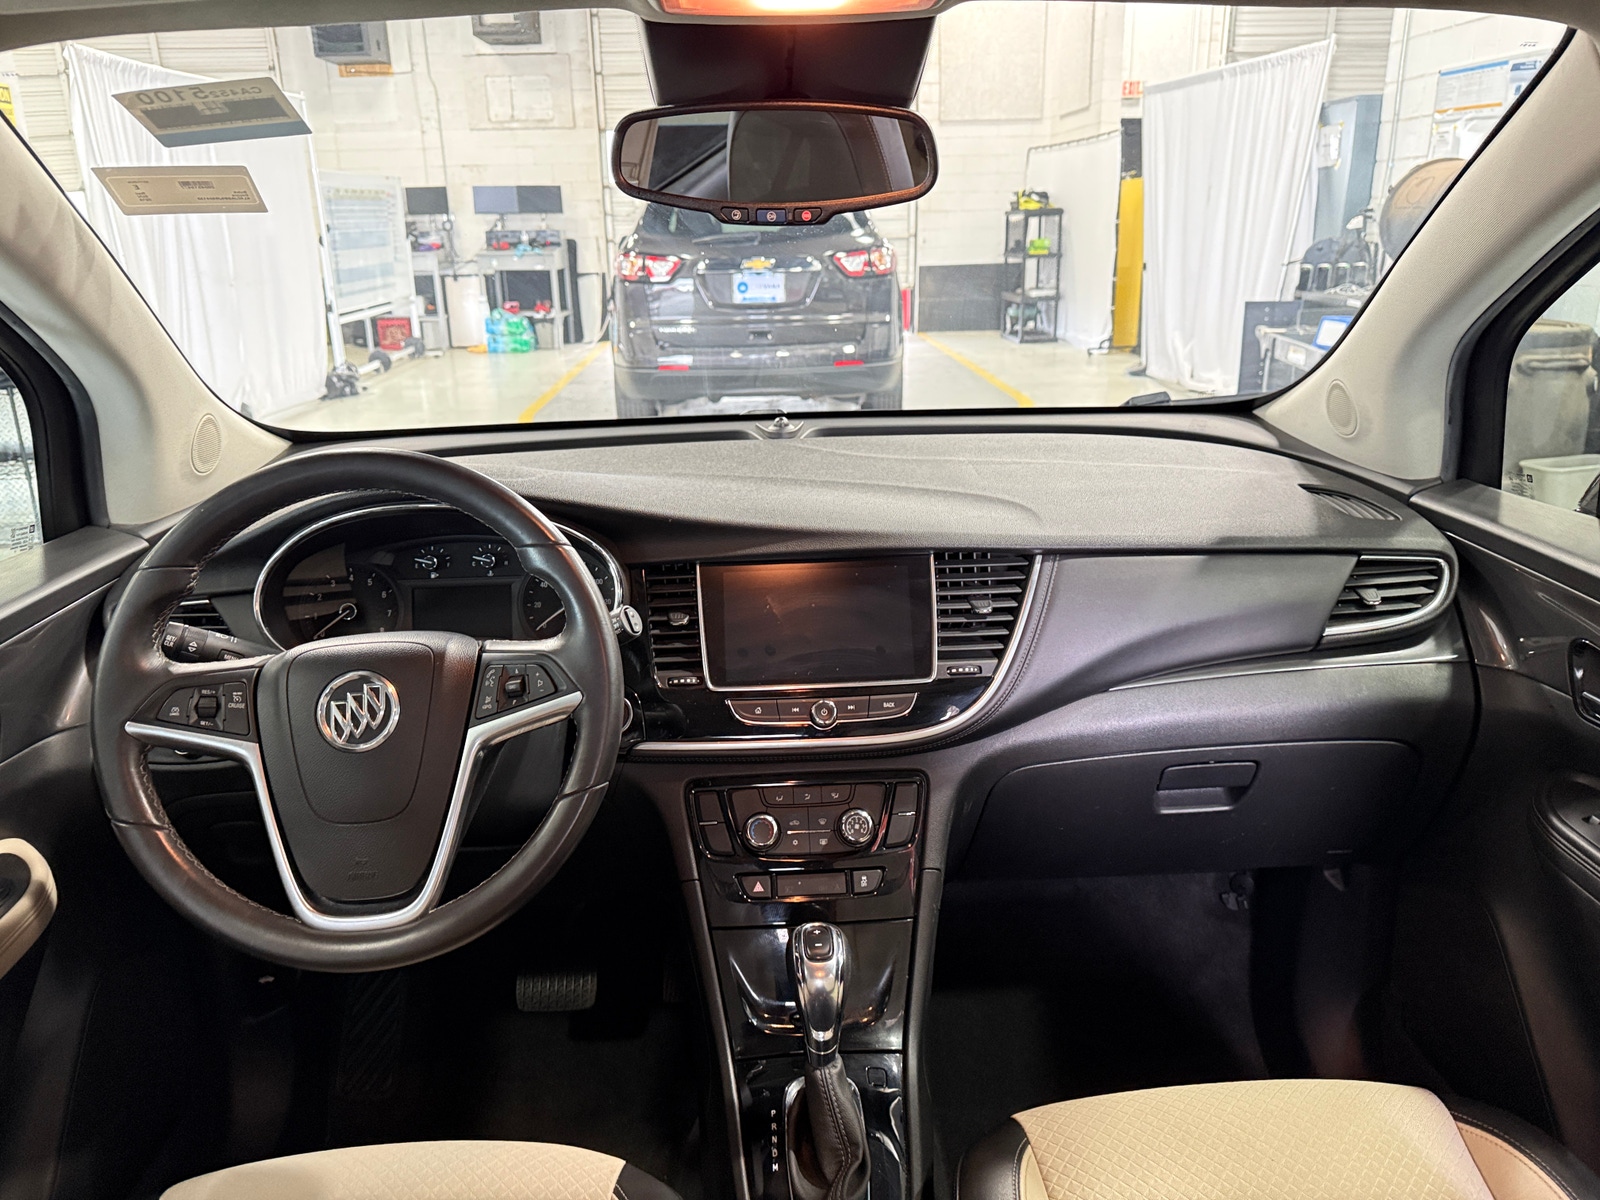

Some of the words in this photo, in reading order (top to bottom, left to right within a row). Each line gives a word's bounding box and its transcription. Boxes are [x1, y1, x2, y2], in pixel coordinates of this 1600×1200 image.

[1122, 80, 1144, 97] EXI
[367, 578, 373, 586] 5
[770, 1109, 776, 1117] P
[771, 1122, 778, 1131] R
[771, 1135, 778, 1144] N
[772, 1149, 778, 1158] D
[772, 1162, 779, 1172] M
